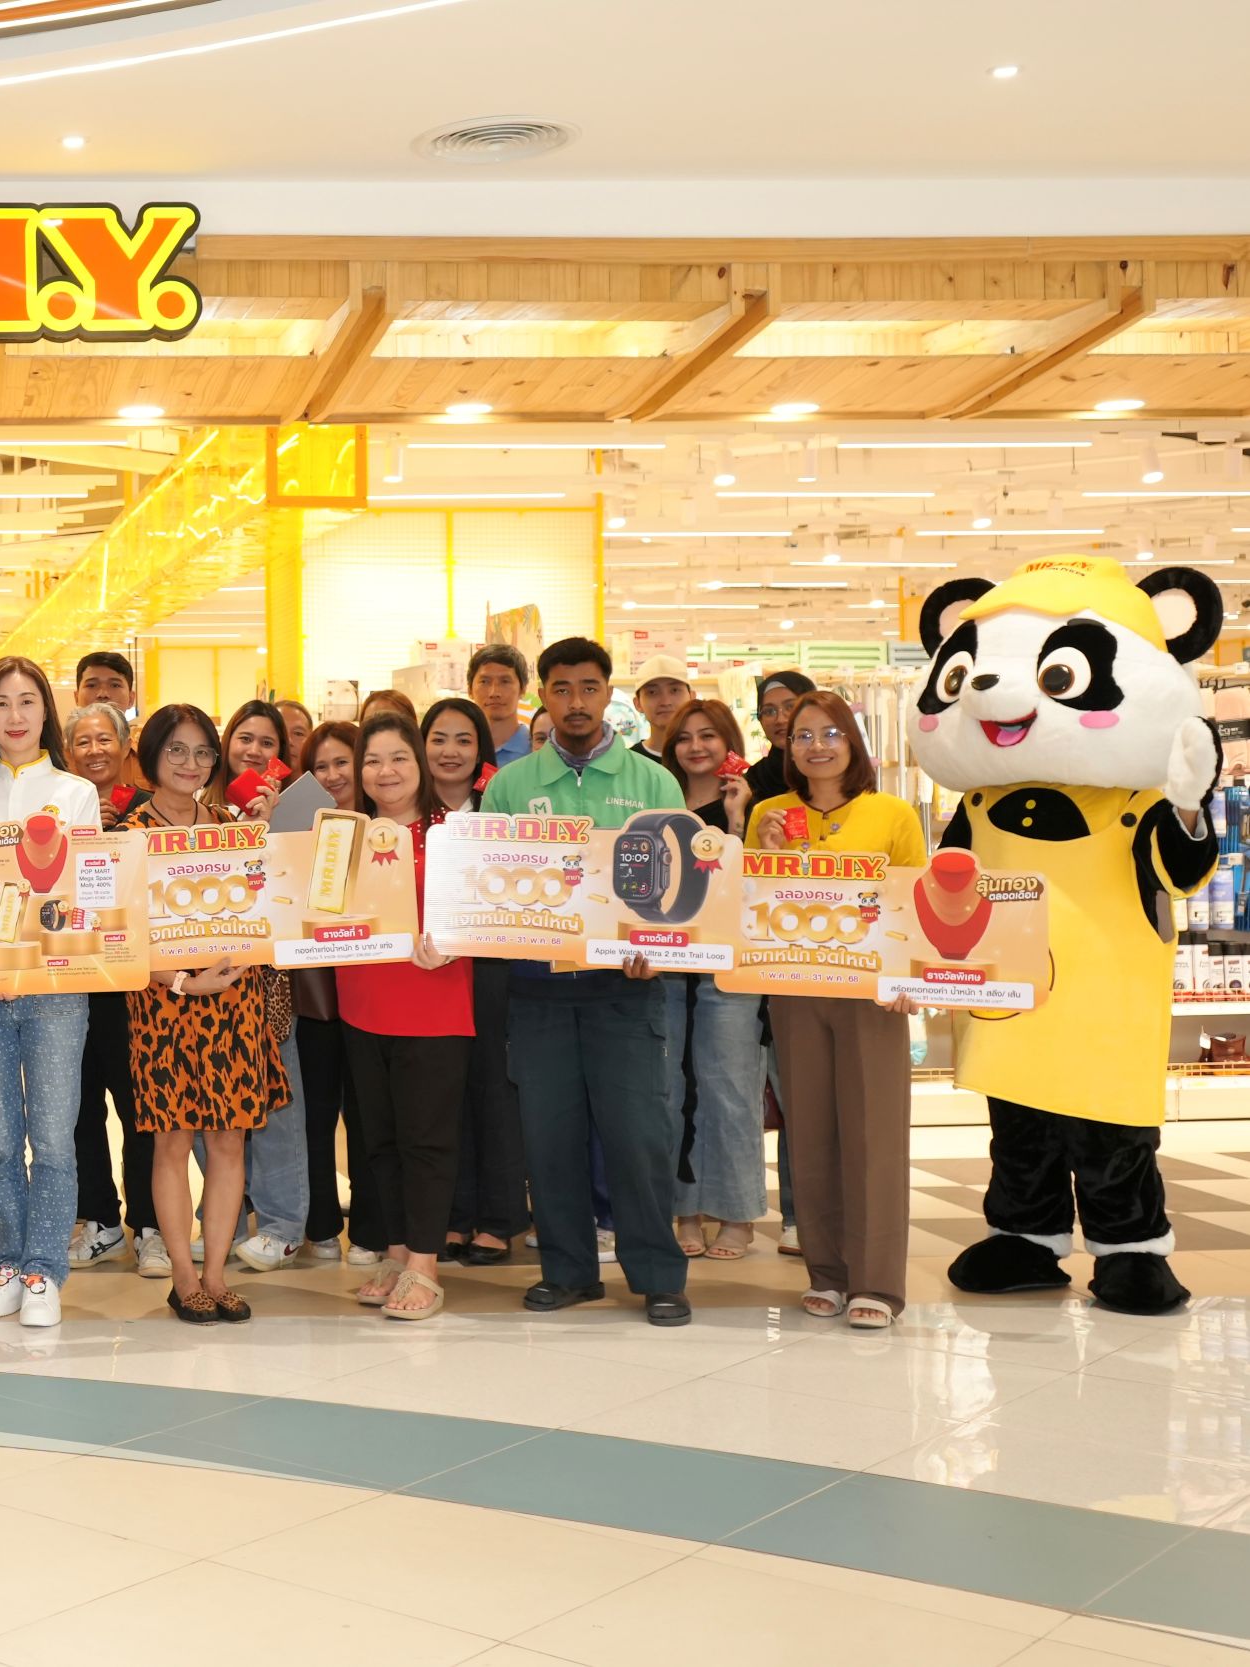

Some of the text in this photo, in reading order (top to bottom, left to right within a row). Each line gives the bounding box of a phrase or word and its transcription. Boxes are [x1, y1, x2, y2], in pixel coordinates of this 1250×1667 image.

[702, 839, 712, 852] 3
[620, 854, 650, 863] 10:09
[167, 863, 231, 876] ฉลองครบ
[976, 875, 1038, 897] ลุ้นทอง
[775, 890, 843, 901] ฉลองครบ
[521, 910, 580, 931] จัดใหญ่
[749, 902, 871, 945] 1000
[150, 917, 267, 941] จกหนัก จัดใหญ่
[323, 927, 357, 939] รางวัลที่
[639, 932, 683, 944] รางวัลที่ 3
[209, 945, 218, 953] 31
[595, 948, 616, 956] Apple
[742, 946, 877, 969] แจกหนัก จัดใหญ่
[848, 975, 859, 983] 68
[926, 968, 982, 982] รางวัลพิเศษ
